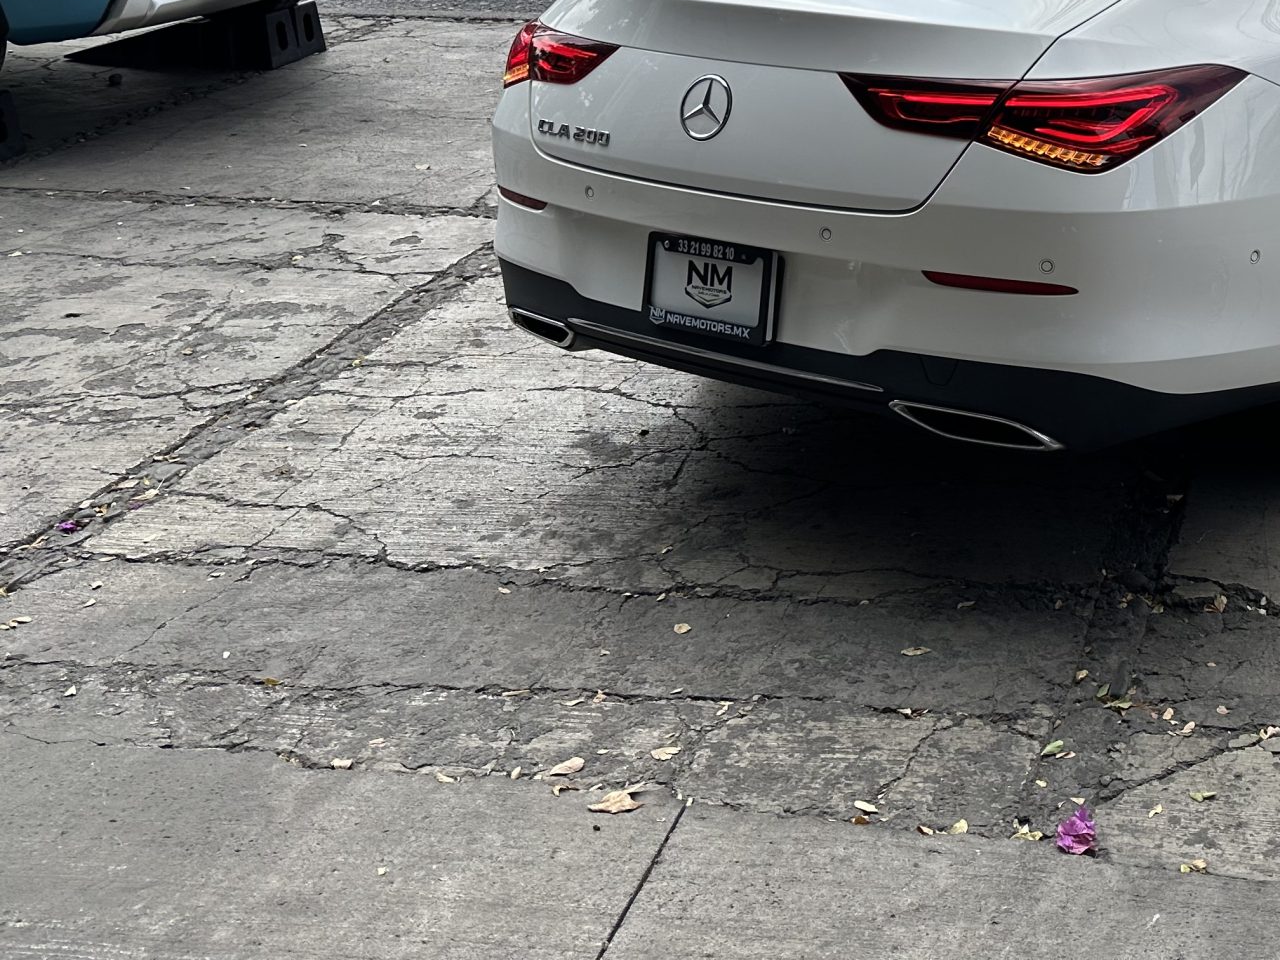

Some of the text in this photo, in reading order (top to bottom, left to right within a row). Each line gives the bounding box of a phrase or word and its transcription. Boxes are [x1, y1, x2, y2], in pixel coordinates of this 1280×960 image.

[538, 118, 610, 147] CLA 200
[678, 239, 735, 260] 33 21 99 82 10
[686, 259, 733, 293] NM
[650, 307, 750, 339] NM NAVEMOTORS.MX
